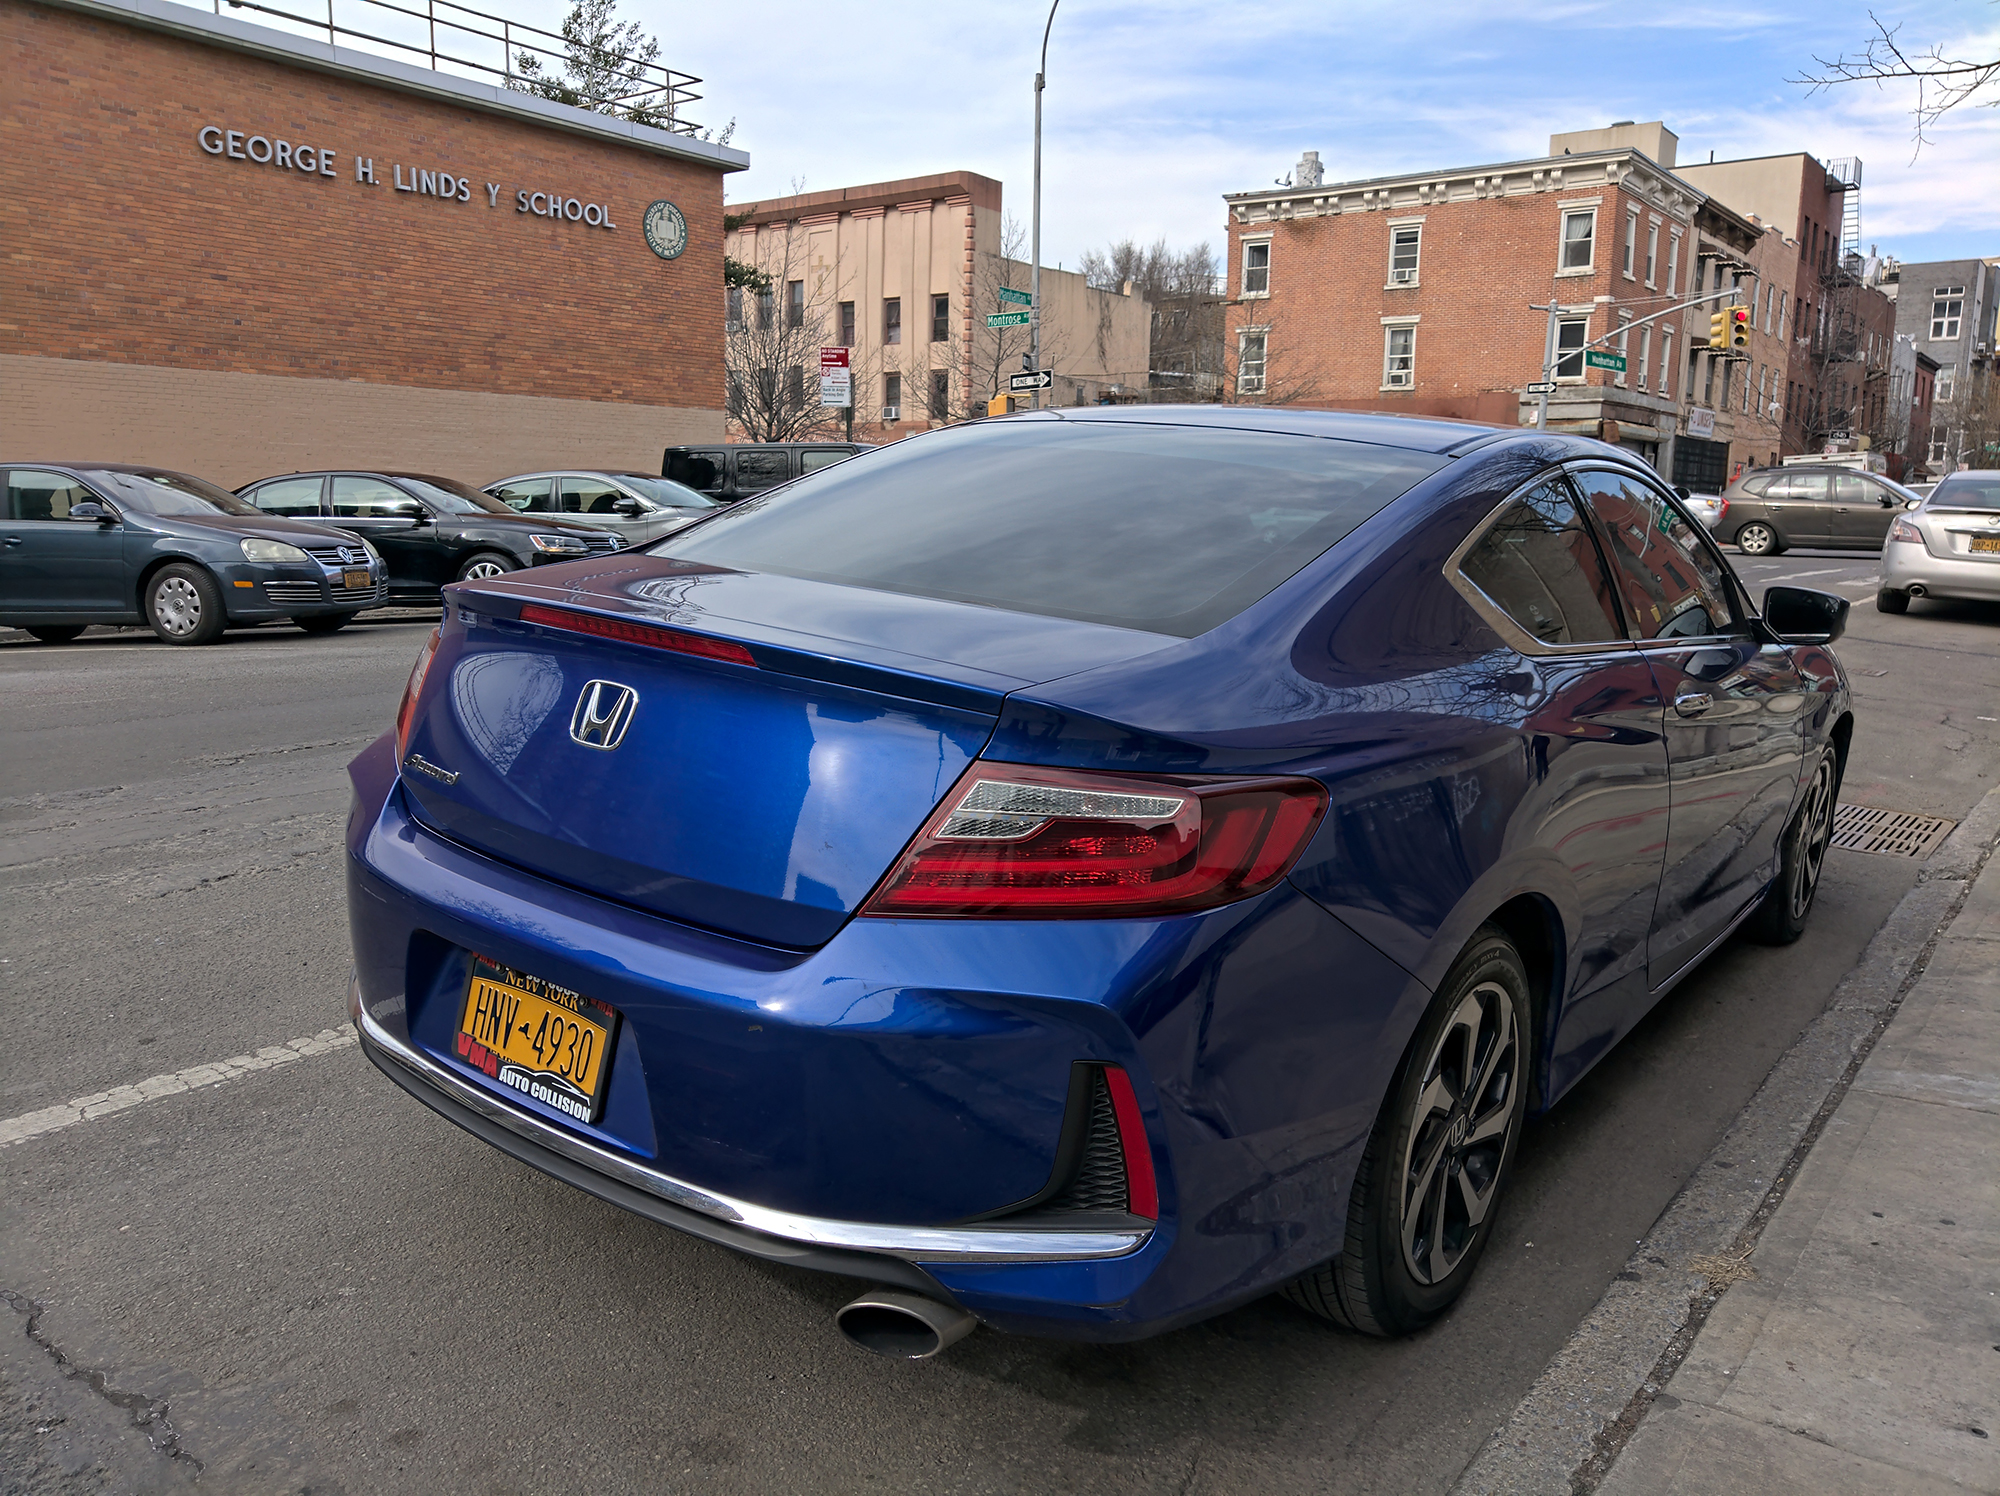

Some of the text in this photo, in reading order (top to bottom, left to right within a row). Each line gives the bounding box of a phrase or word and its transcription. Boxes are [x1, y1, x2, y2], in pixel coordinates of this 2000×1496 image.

[198, 125, 337, 178] GEORGE
[355, 156, 379, 186] H.
[515, 189, 617, 229] SCHOOL
[1000, 288, 1026, 304] Manhattan
[987, 314, 1022, 326] Montrose
[1591, 355, 1615, 367] Manhattan
[1016, 375, 1046, 386] ONE WAY
[404, 754, 461, 786] Accord
[505, 970, 540, 994] NEW
[544, 986, 580, 1013] YORK
[457, 1032, 498, 1079] VMA
[498, 1067, 592, 1124] AUTO COLLISION
